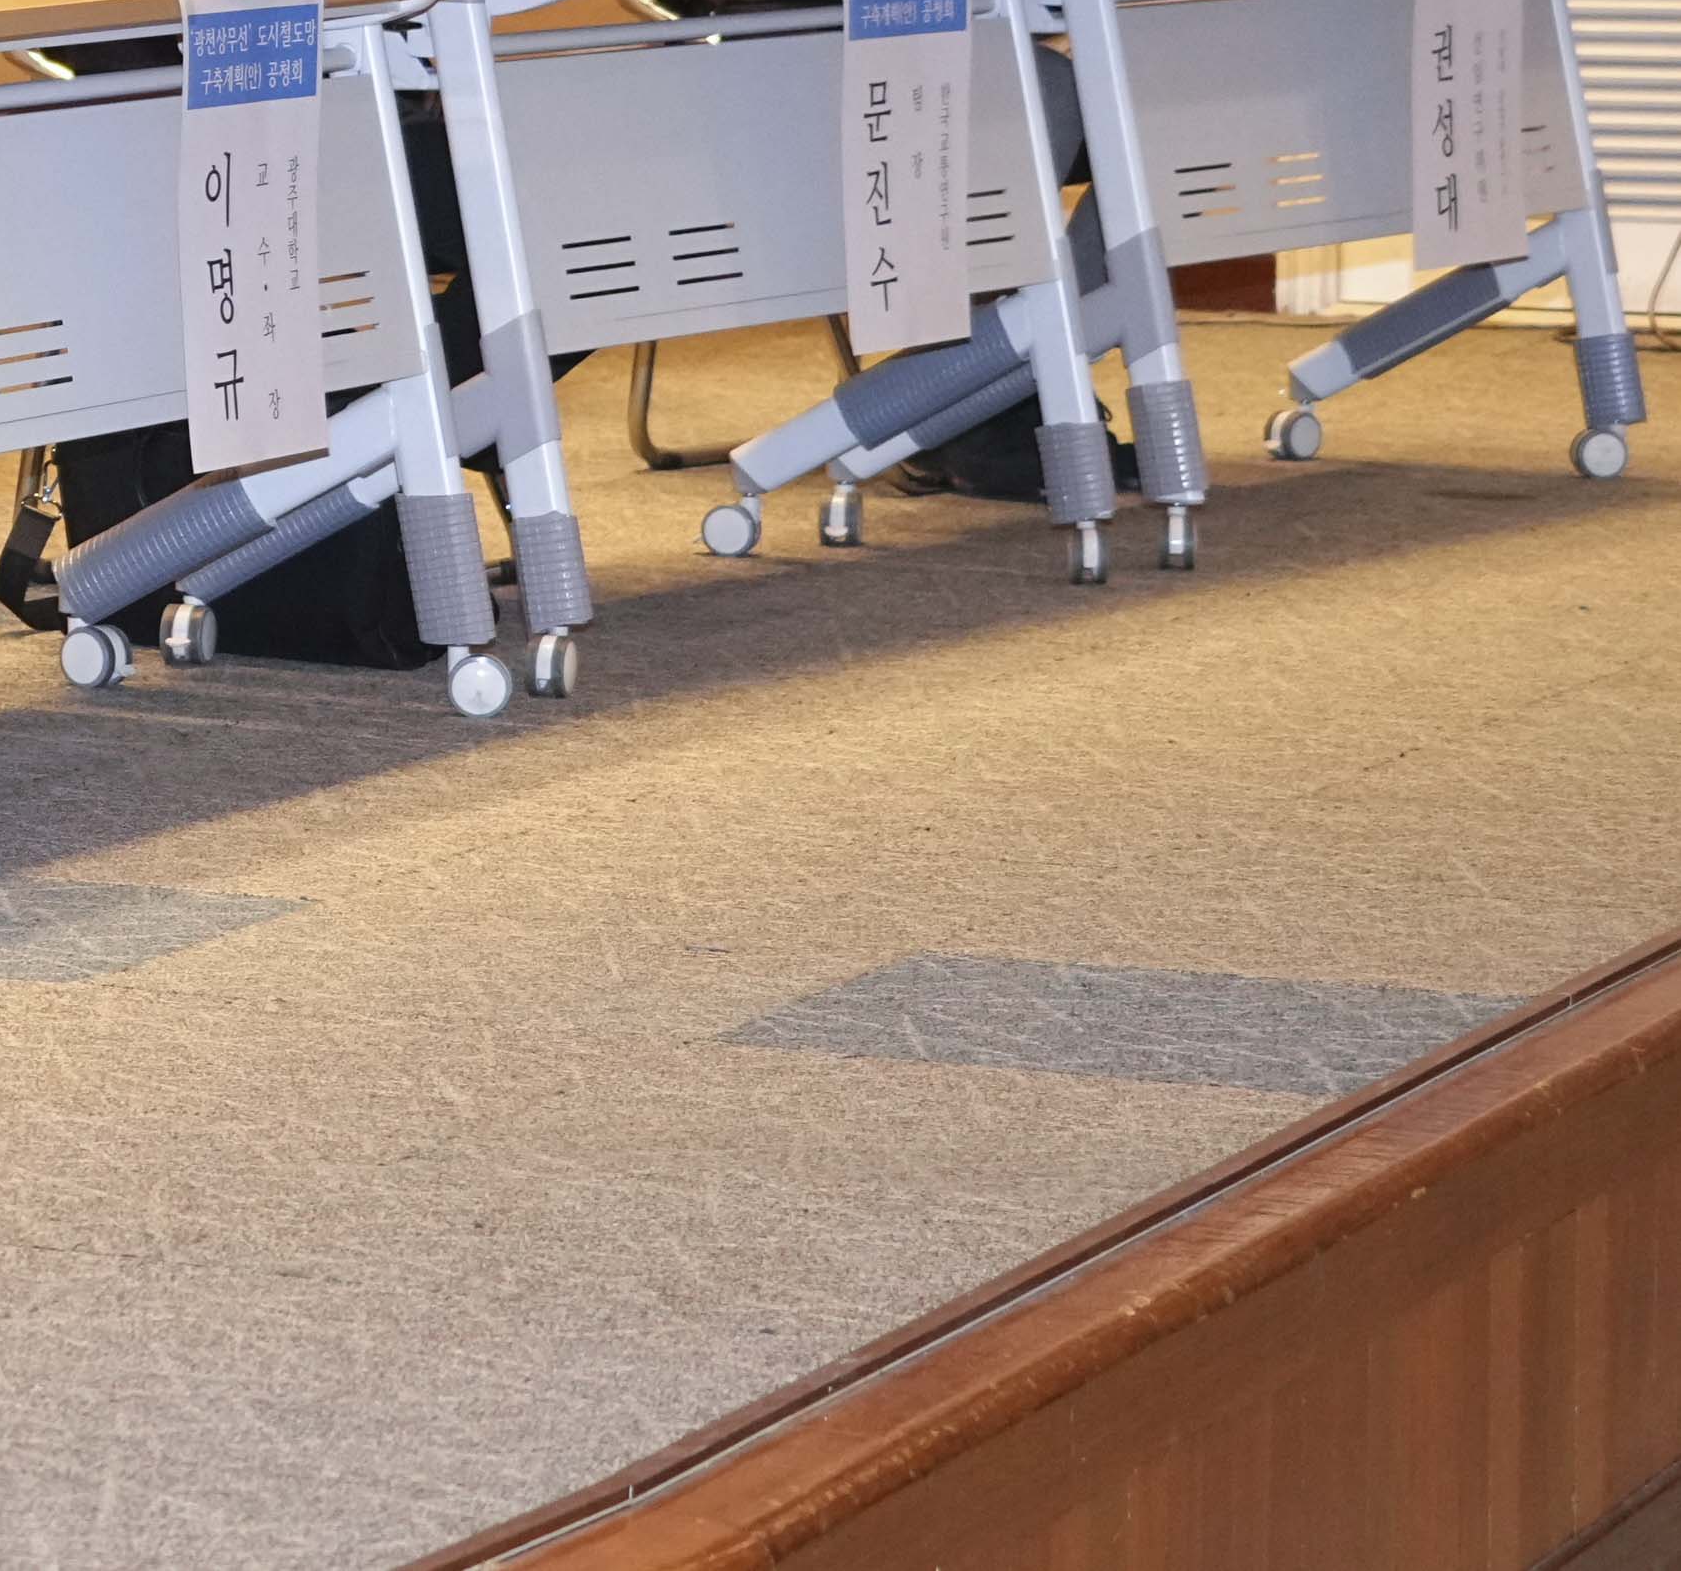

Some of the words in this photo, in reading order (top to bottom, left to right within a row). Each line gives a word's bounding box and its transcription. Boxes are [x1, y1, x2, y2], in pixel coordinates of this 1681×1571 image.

[200, 62, 262, 95] 구축계획(안)
[267, 58, 303, 88] 공청회
[256, 18, 316, 49] 도시철도망
[863, 81, 899, 311] 문진수
[1431, 23, 1459, 232] 권성대
[205, 151, 245, 422] 이명규
[287, 155, 302, 290] 광주대학교
